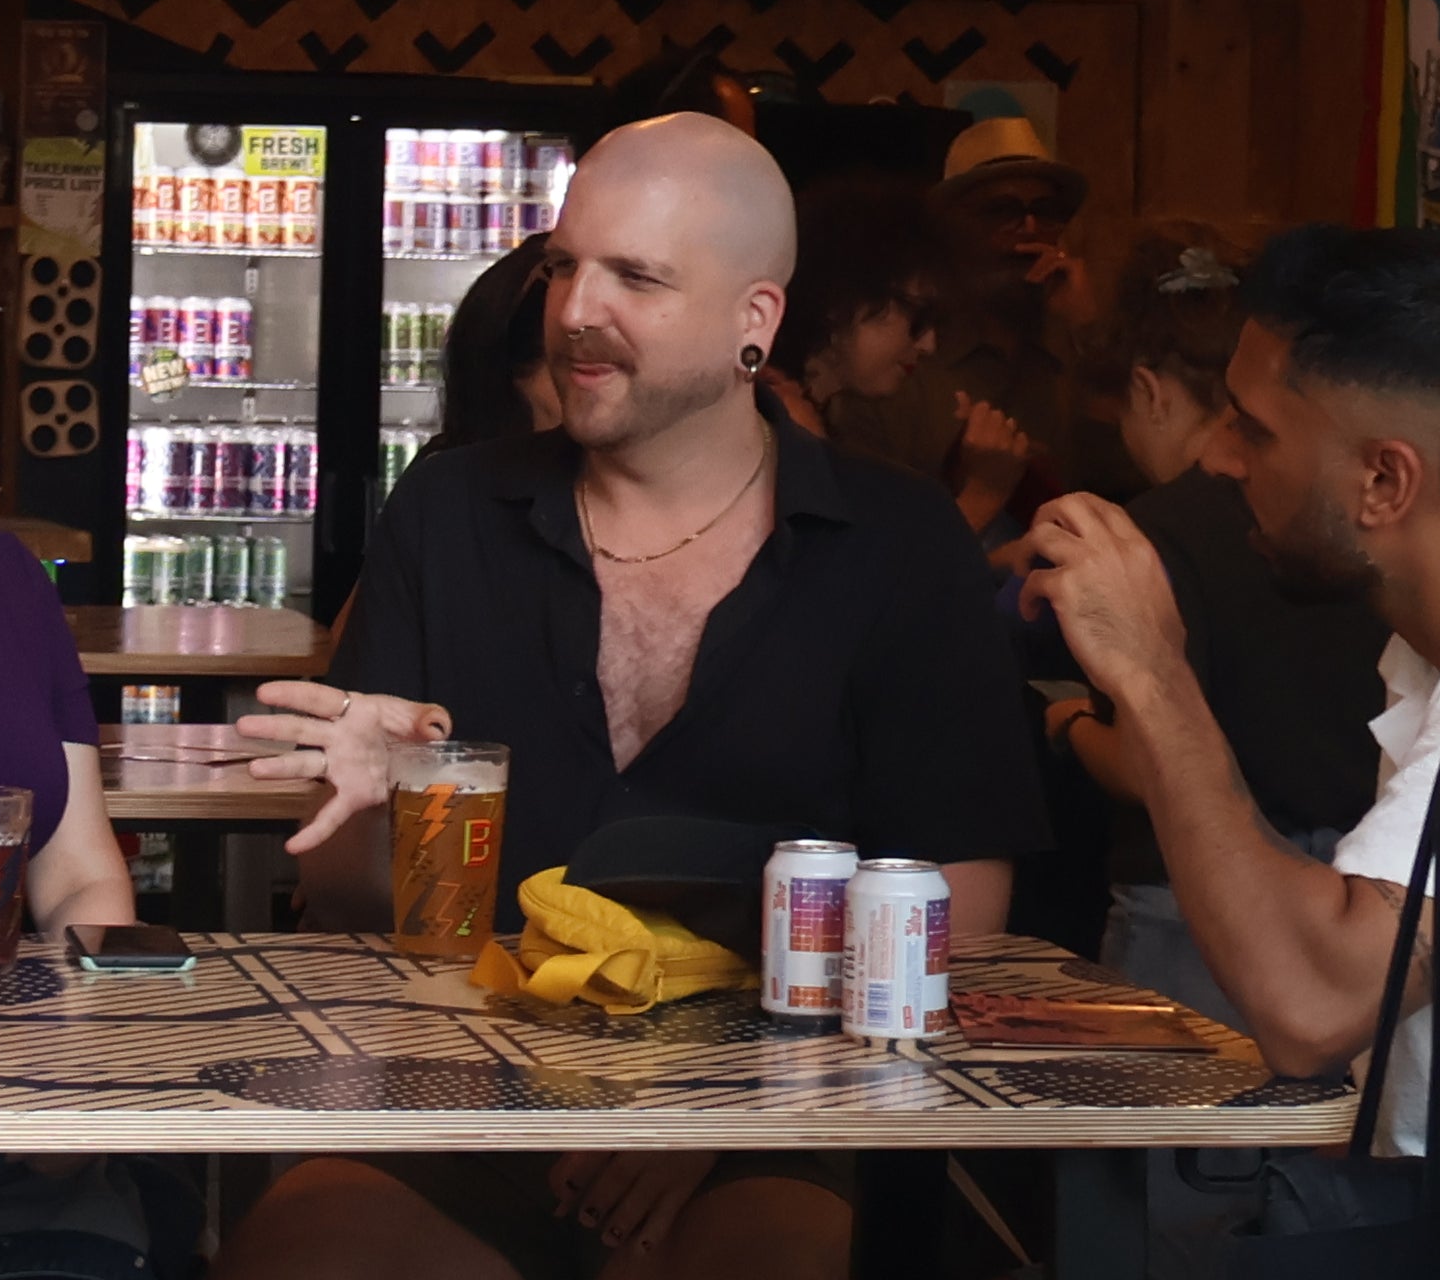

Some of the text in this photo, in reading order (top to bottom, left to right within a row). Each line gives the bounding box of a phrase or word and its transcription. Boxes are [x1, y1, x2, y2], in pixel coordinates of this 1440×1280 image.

[248, 136, 319, 157] FRESH
[25, 177, 102, 191] PRICE LIST
[462, 818, 492, 868] B
